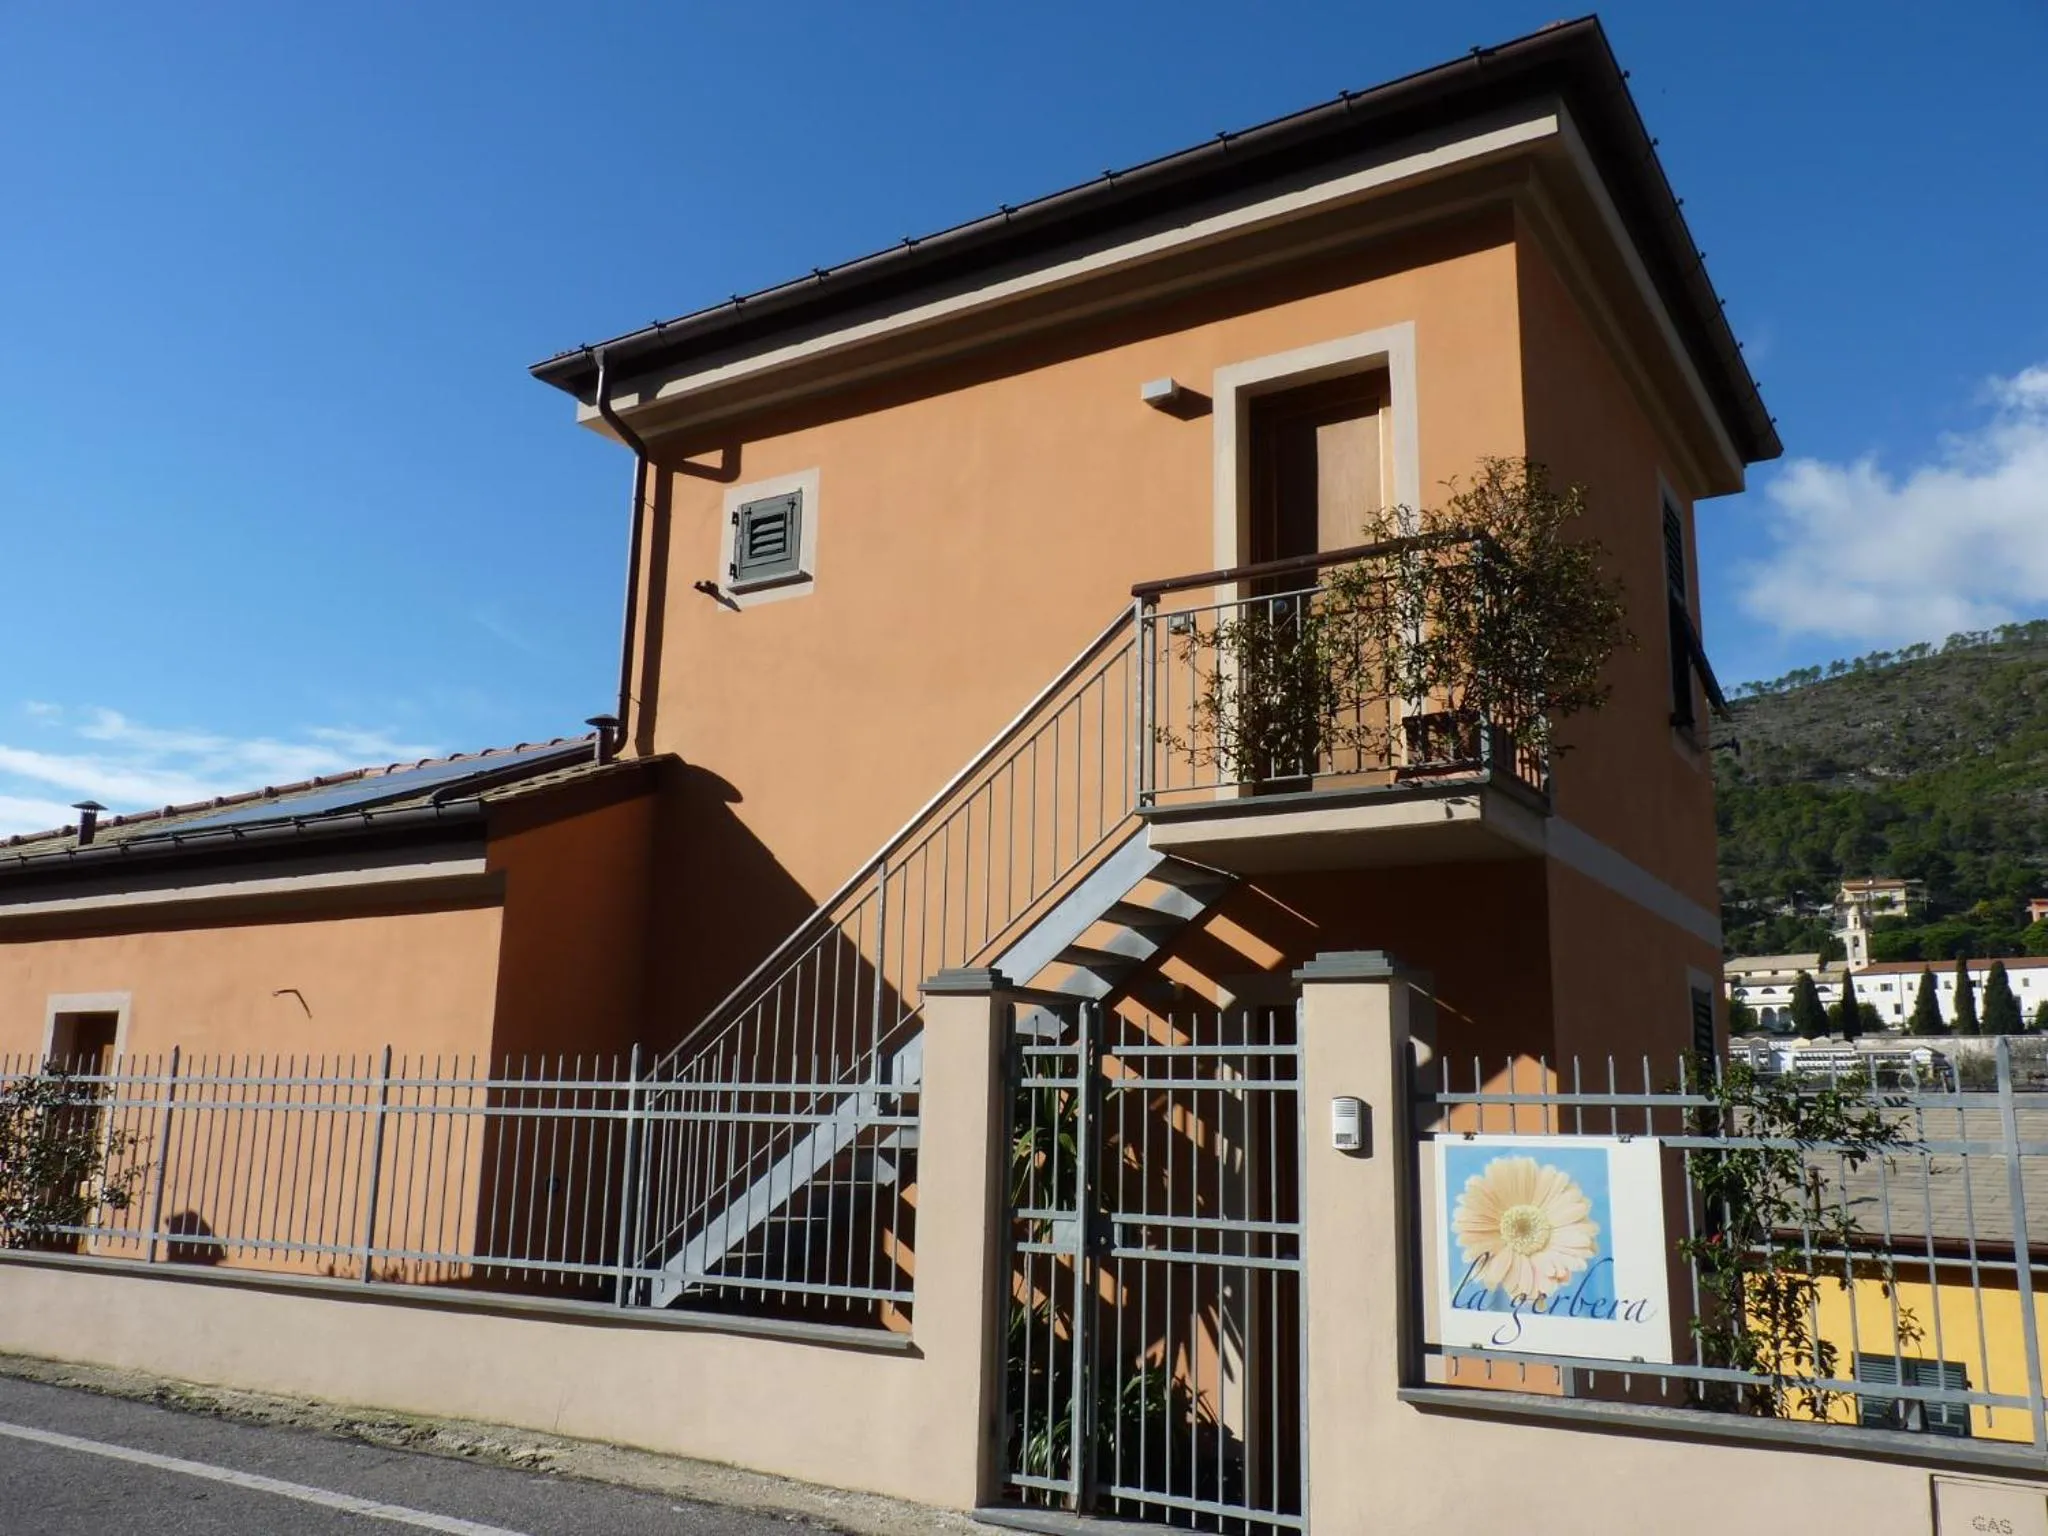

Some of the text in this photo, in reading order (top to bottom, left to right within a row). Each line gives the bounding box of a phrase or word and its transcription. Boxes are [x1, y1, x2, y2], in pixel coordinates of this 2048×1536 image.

[1452, 1250, 1656, 1345] la gerbera
[1971, 1514, 2013, 1536] GAS
